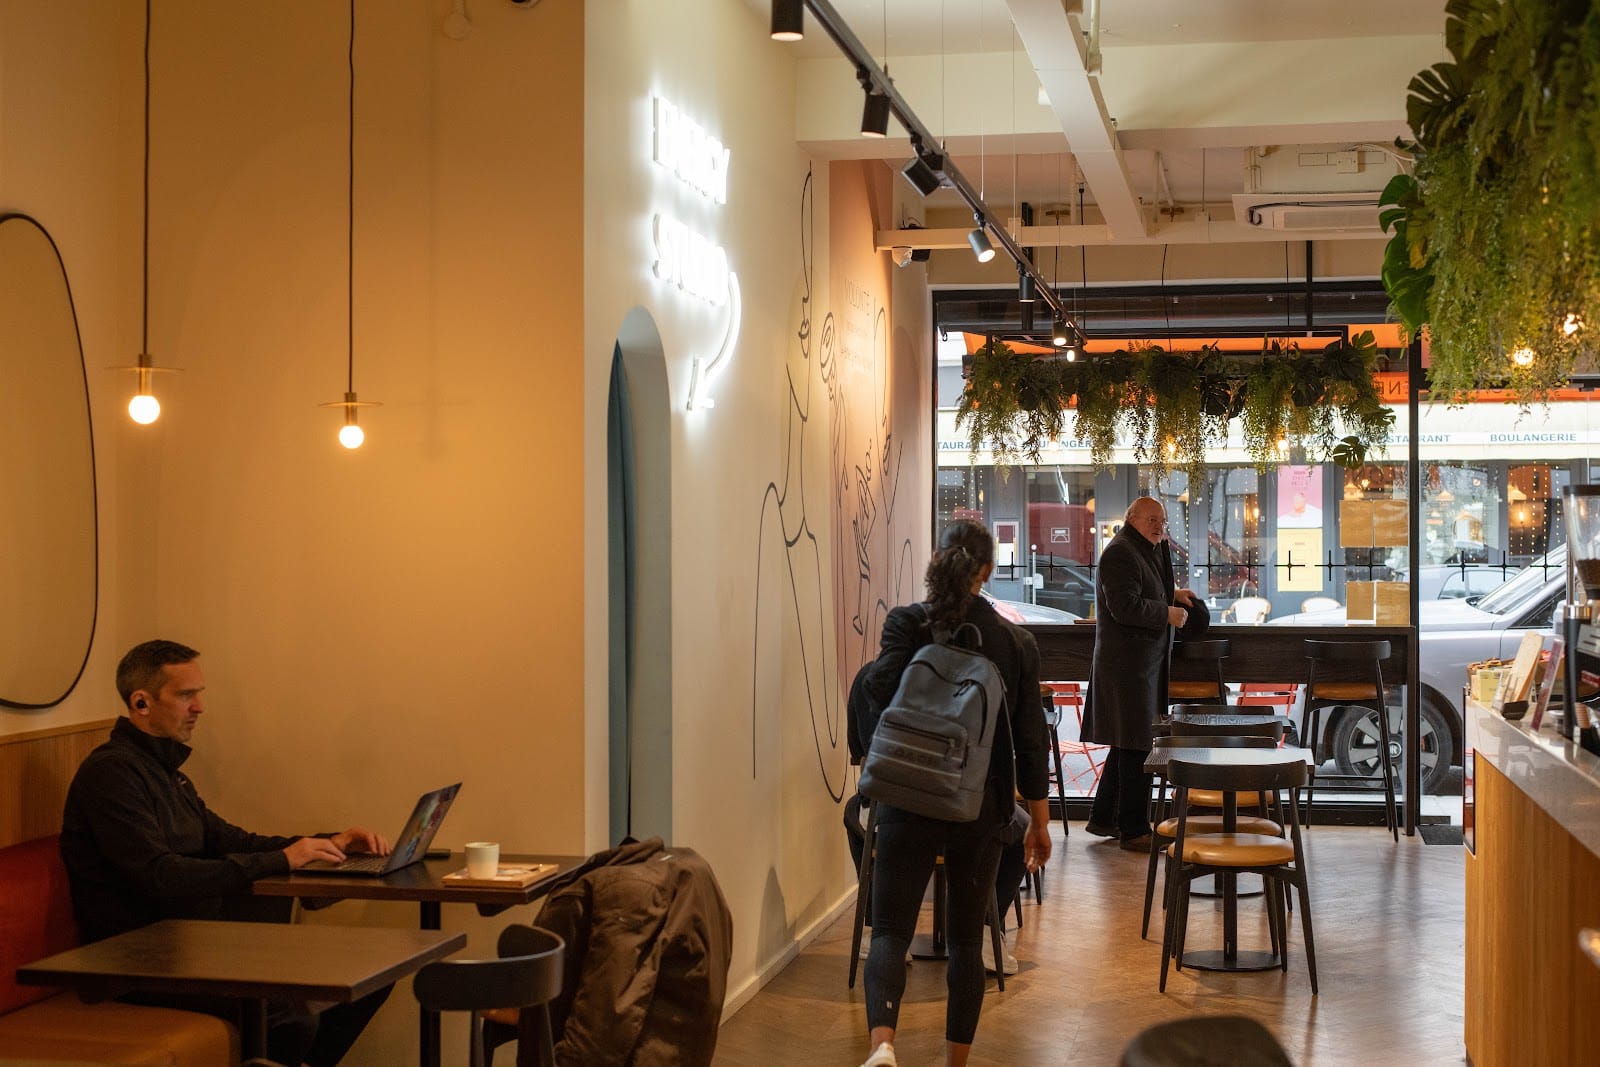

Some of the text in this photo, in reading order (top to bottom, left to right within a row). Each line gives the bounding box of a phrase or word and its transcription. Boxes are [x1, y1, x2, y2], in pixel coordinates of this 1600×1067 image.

[937, 433, 1577, 449] TAURAT STARANT BOULANGERIE
